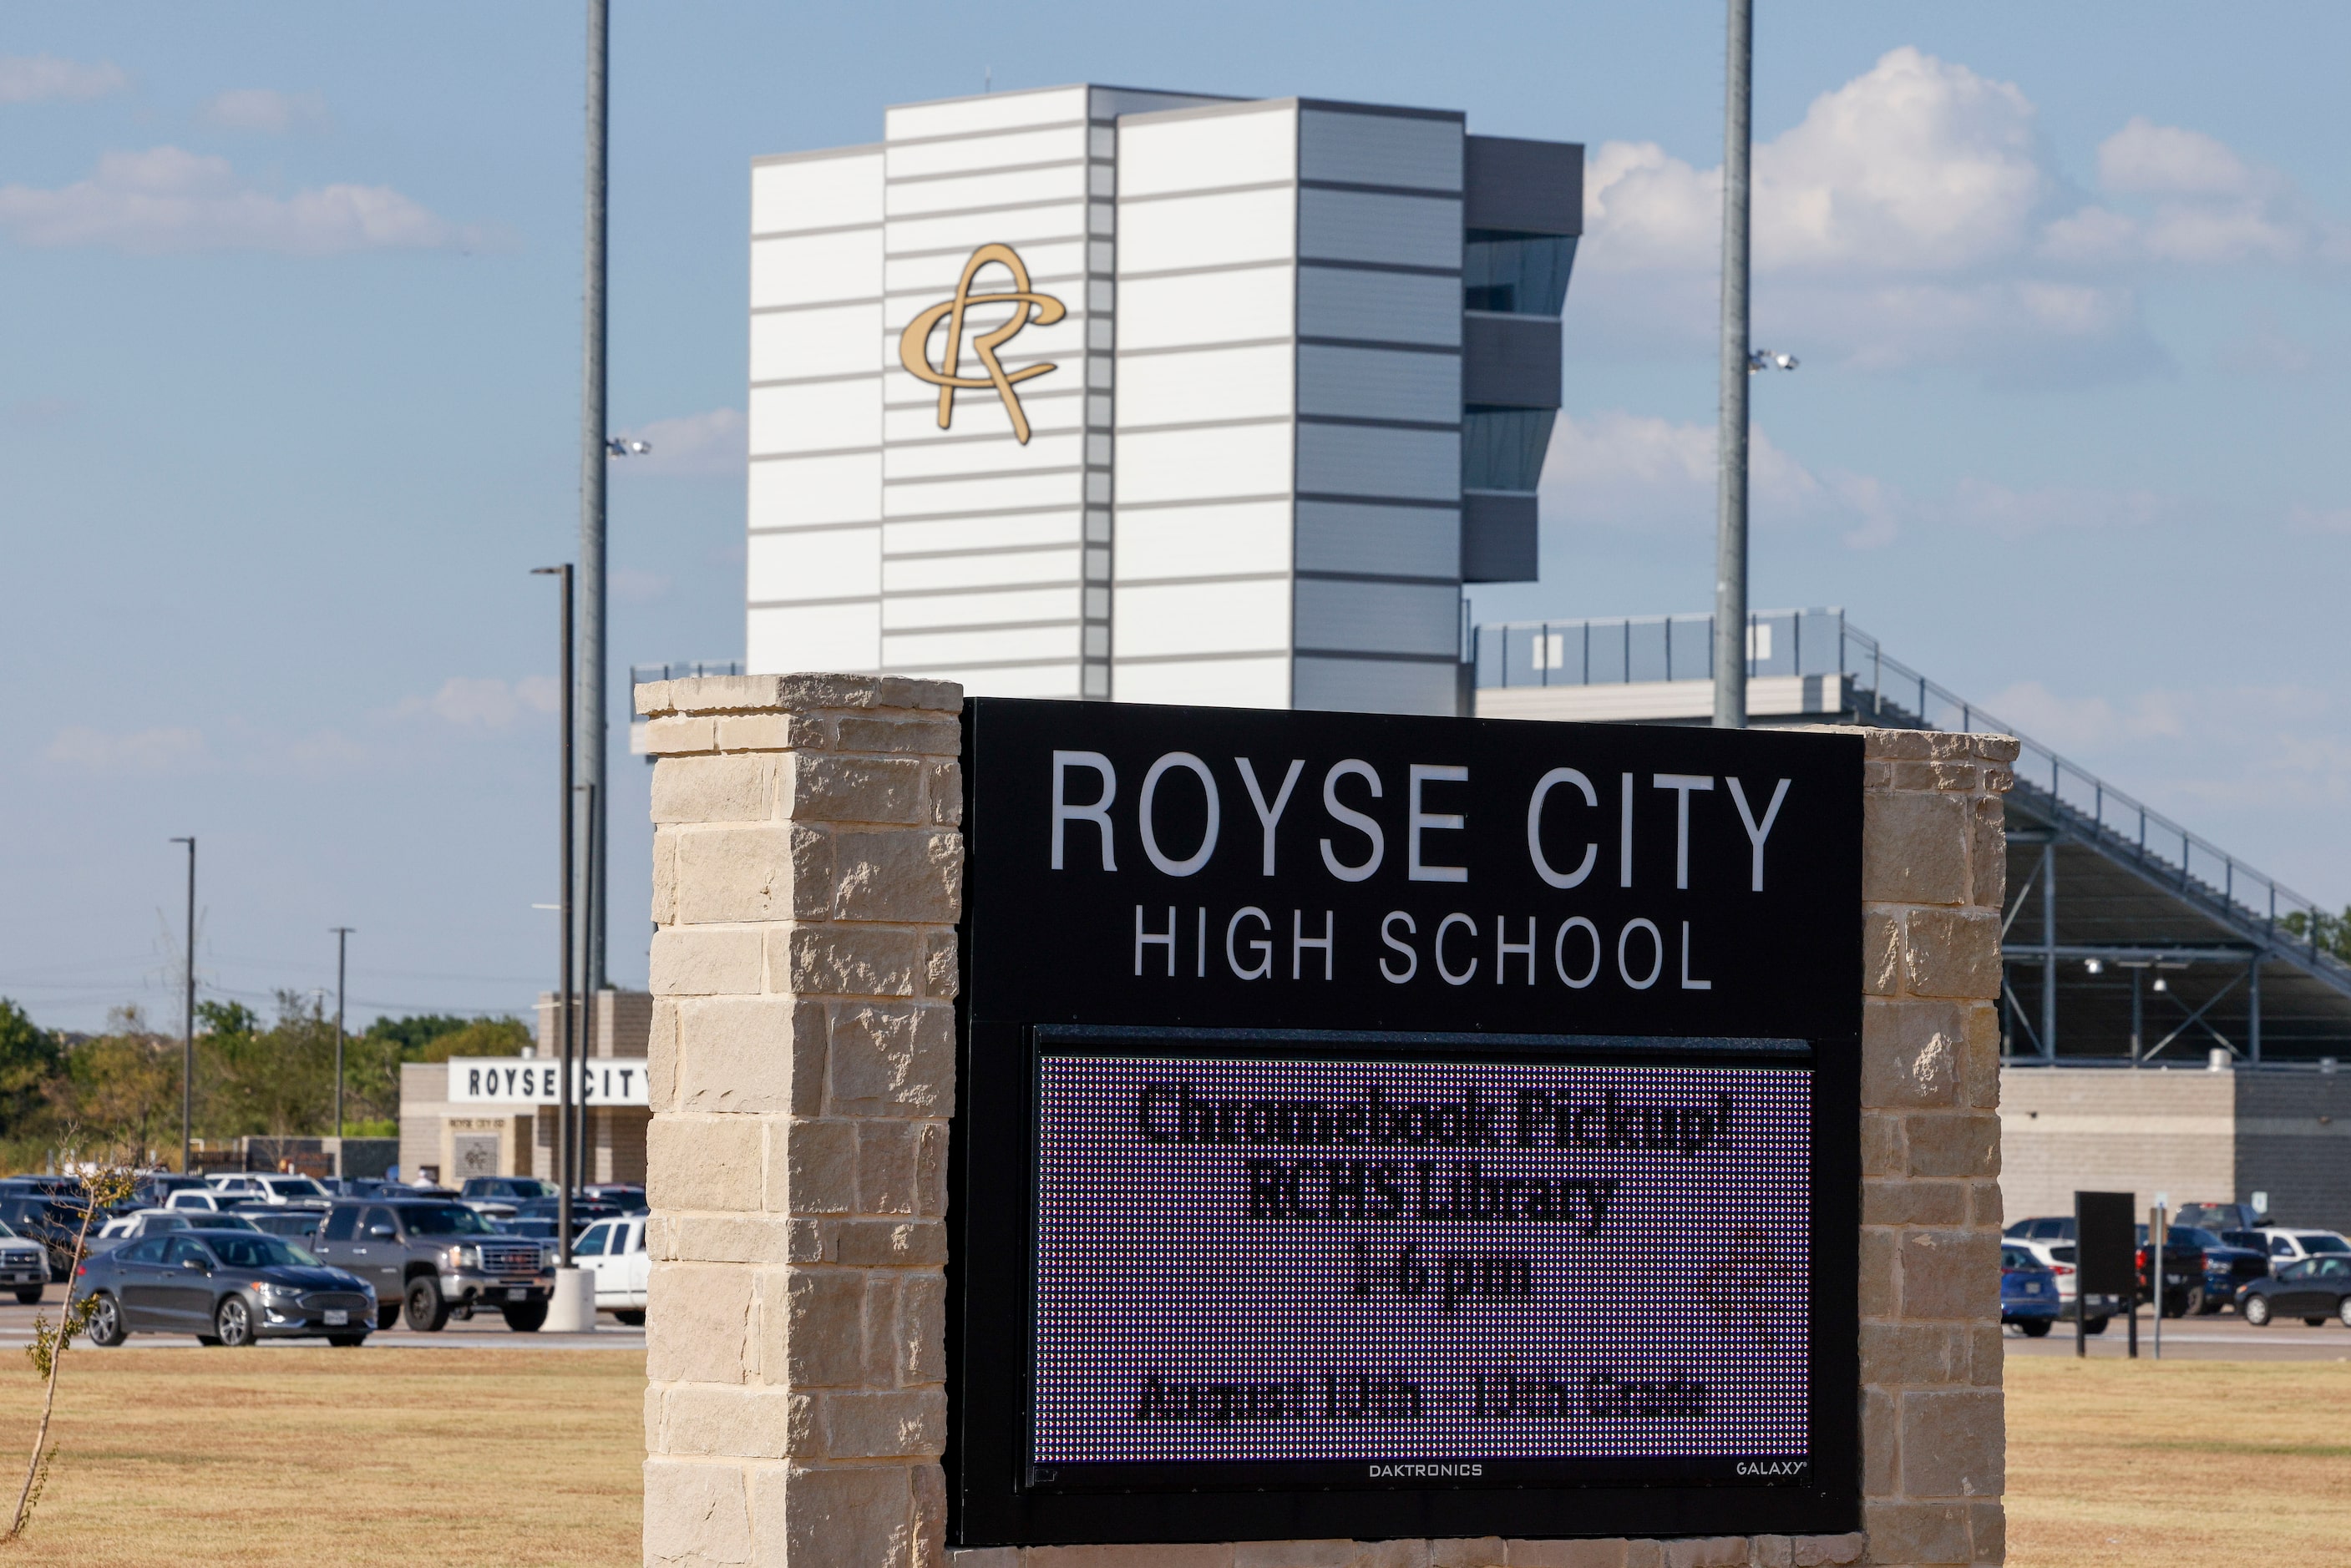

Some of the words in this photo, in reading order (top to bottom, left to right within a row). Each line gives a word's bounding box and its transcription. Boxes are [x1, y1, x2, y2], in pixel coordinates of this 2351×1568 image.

[1051, 749, 1468, 883] ROYSE
[1528, 766, 1792, 893] CITY
[1134, 904, 1333, 981] HIGH
[1379, 911, 1712, 990] SCHOOL
[469, 1069, 555, 1096] ROYSE
[584, 1069, 649, 1097] CIT
[1138, 1082, 1497, 1147] Chromebook
[1516, 1087, 1733, 1158] Pickup!
[1247, 1159, 1402, 1220] RCHS
[1416, 1161, 1617, 1237] Library
[1439, 1252, 1533, 1316] pm
[1136, 1368, 1306, 1427] August
[1369, 1464, 1483, 1478] DAKTRONICS
